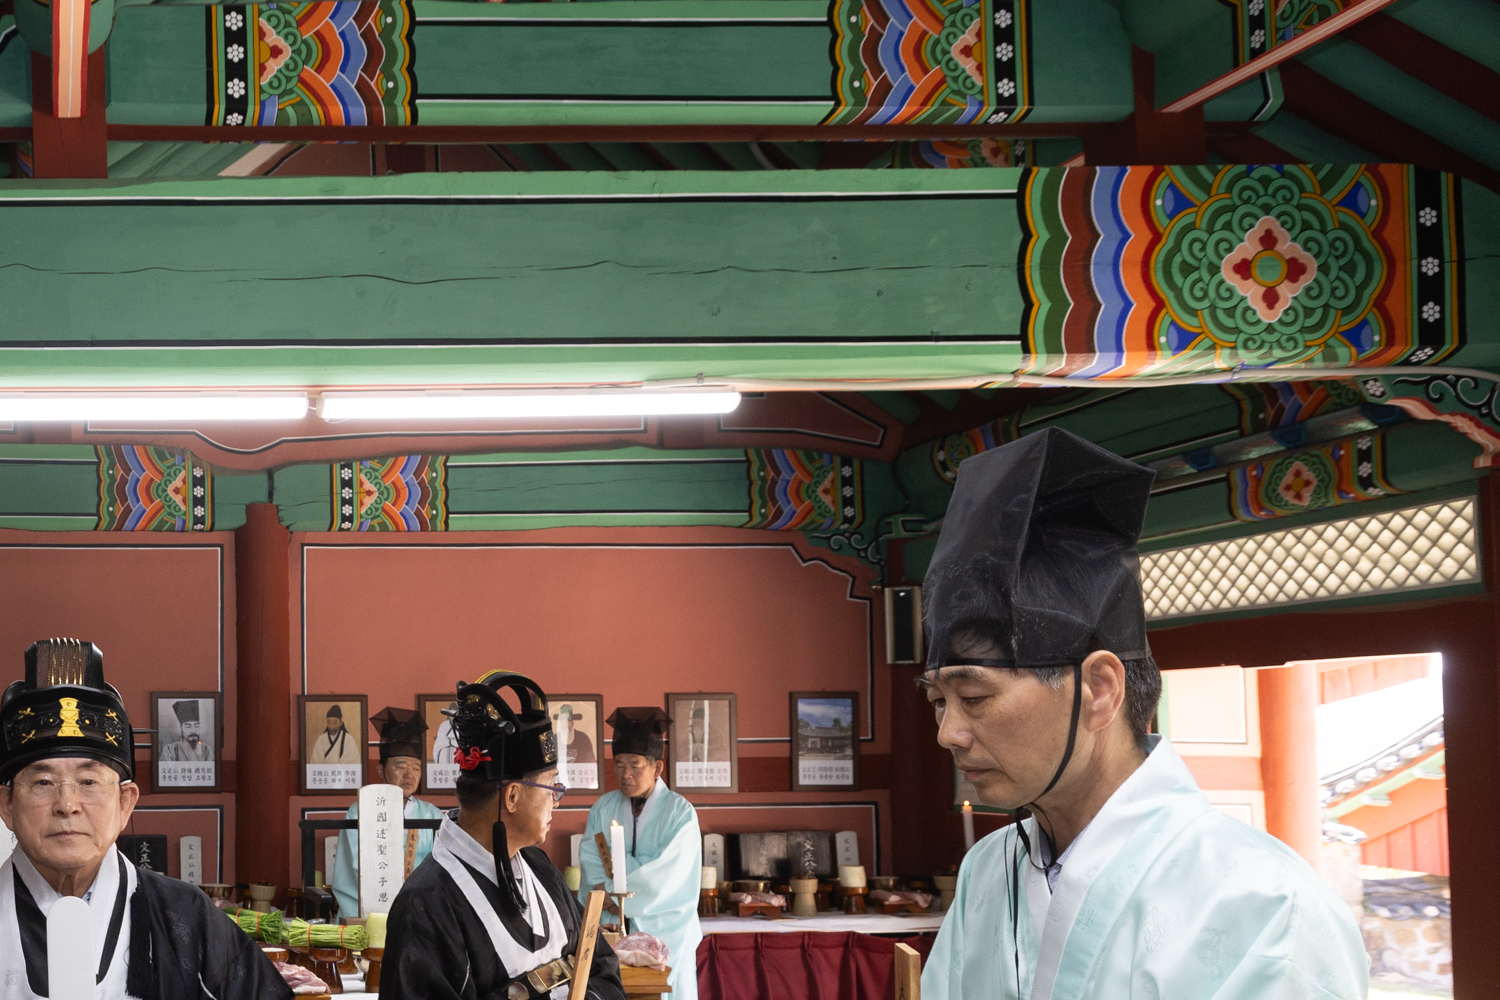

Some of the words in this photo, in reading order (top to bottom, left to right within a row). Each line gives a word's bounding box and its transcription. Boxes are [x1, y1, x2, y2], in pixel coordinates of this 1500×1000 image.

[376, 796, 388, 903] 沂國述聖公子思
